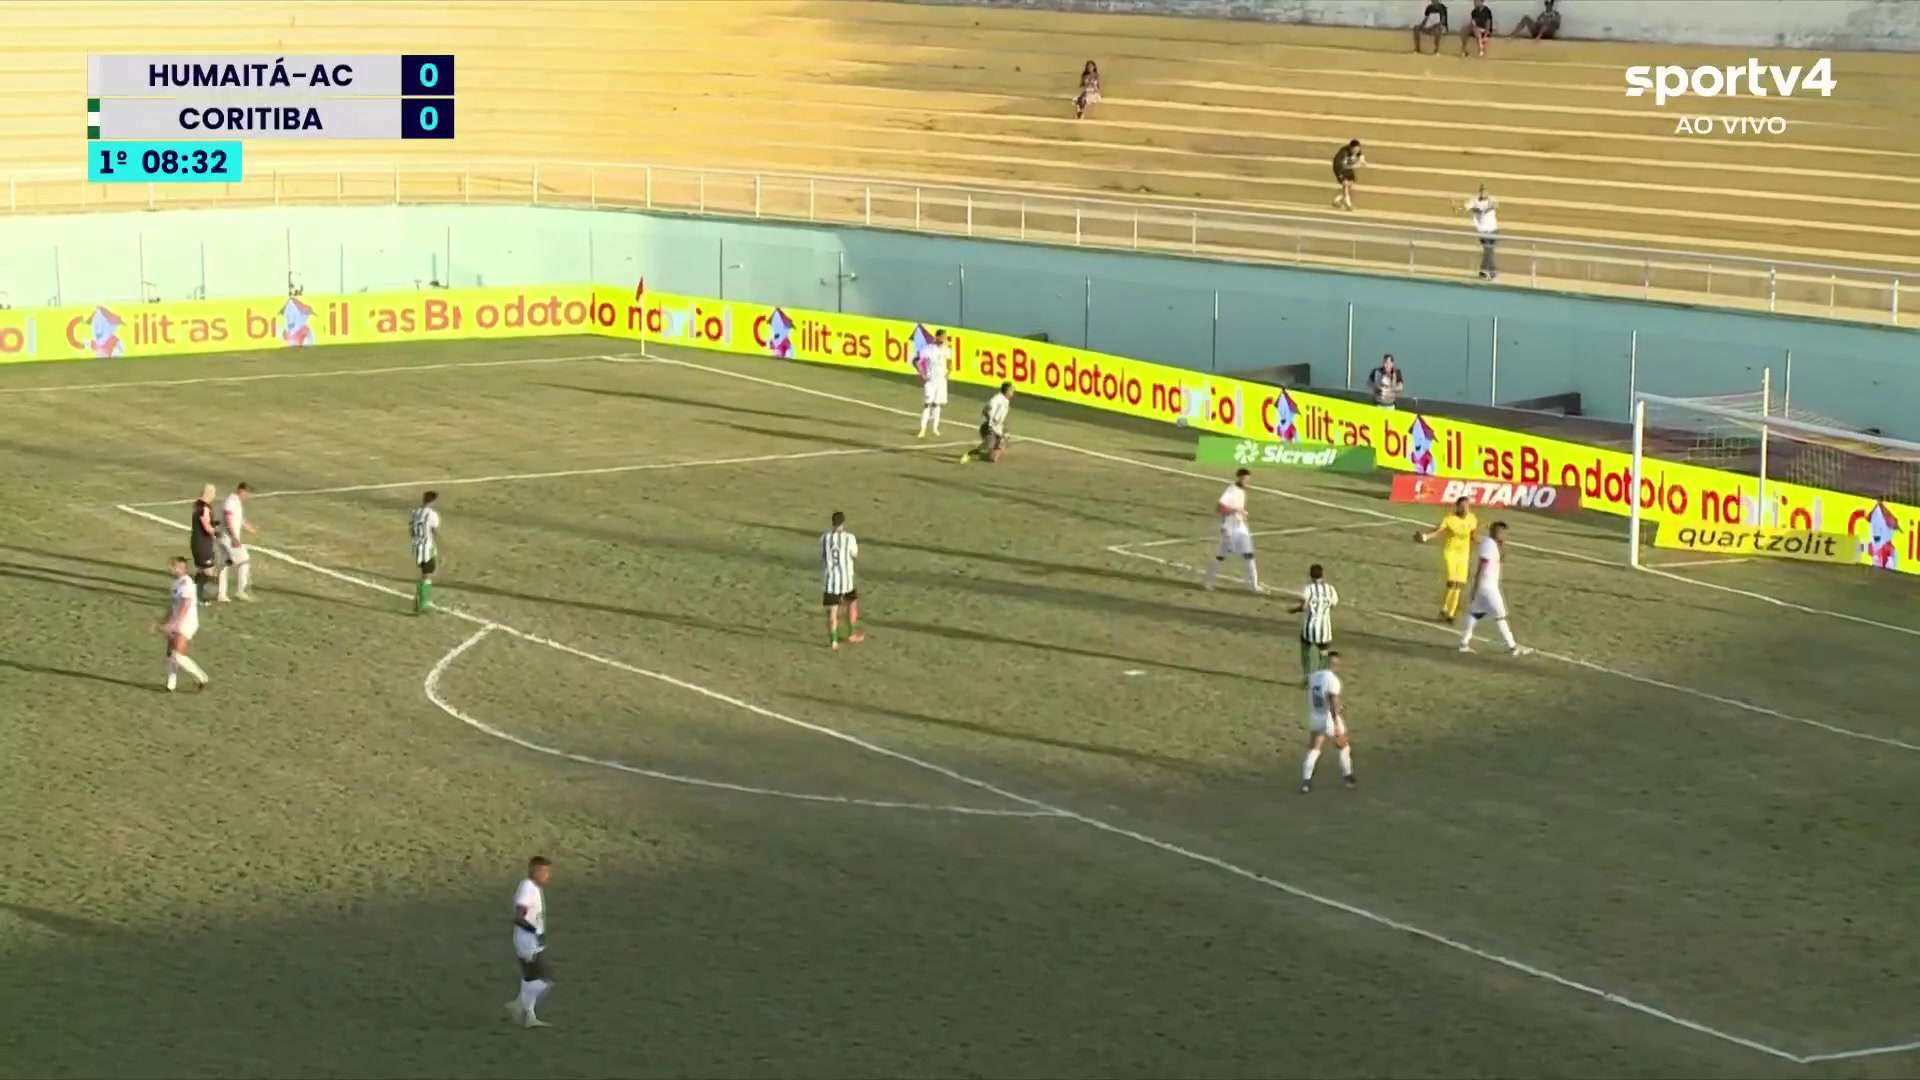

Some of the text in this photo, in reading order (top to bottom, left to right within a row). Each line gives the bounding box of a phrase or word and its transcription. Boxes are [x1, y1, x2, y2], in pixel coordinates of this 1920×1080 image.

[1261, 444, 1338, 467] Sicredi
[1440, 480, 1557, 509] BETANO
[1678, 527, 1837, 557] quartzolit
